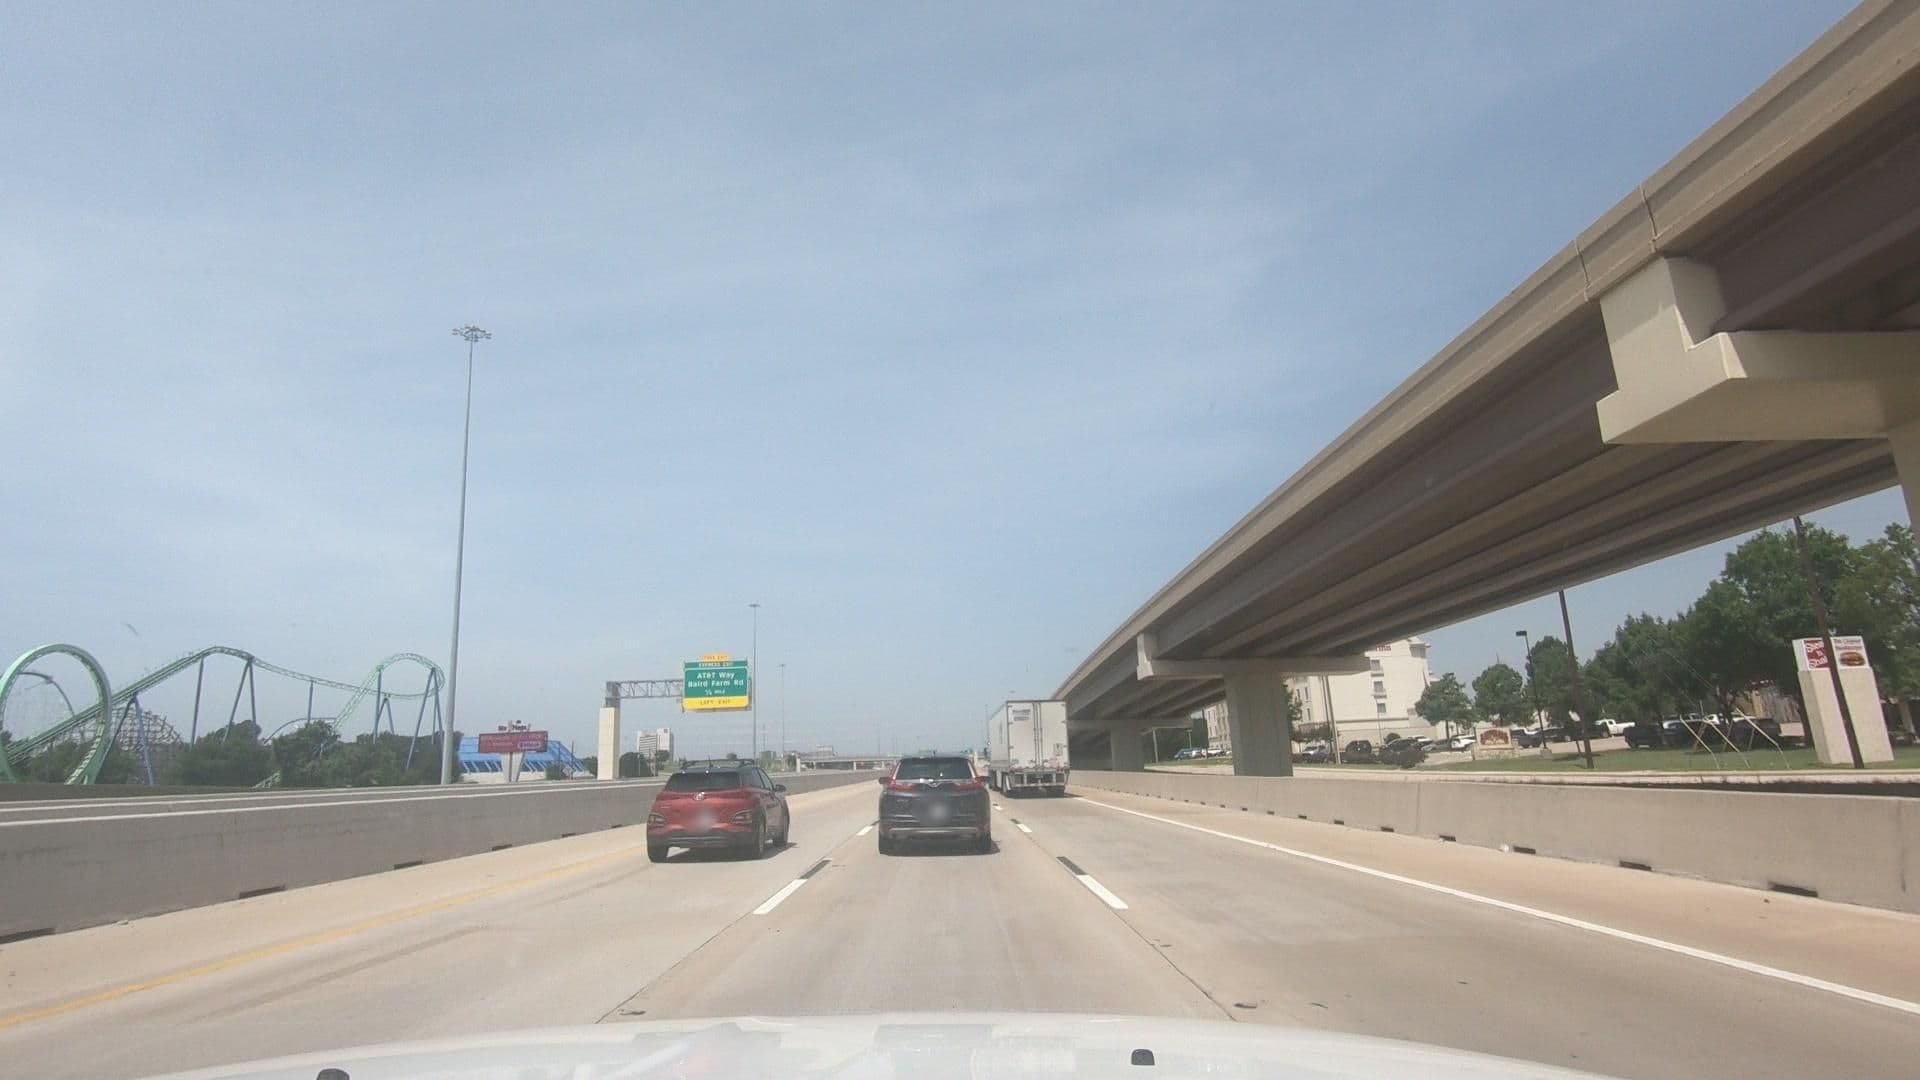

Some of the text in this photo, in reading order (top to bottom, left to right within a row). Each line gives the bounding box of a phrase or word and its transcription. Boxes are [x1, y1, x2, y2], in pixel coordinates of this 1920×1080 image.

[1805, 641, 1825, 653] Stea
[719, 671, 735, 680] Way
[688, 680, 708, 688] Baird
